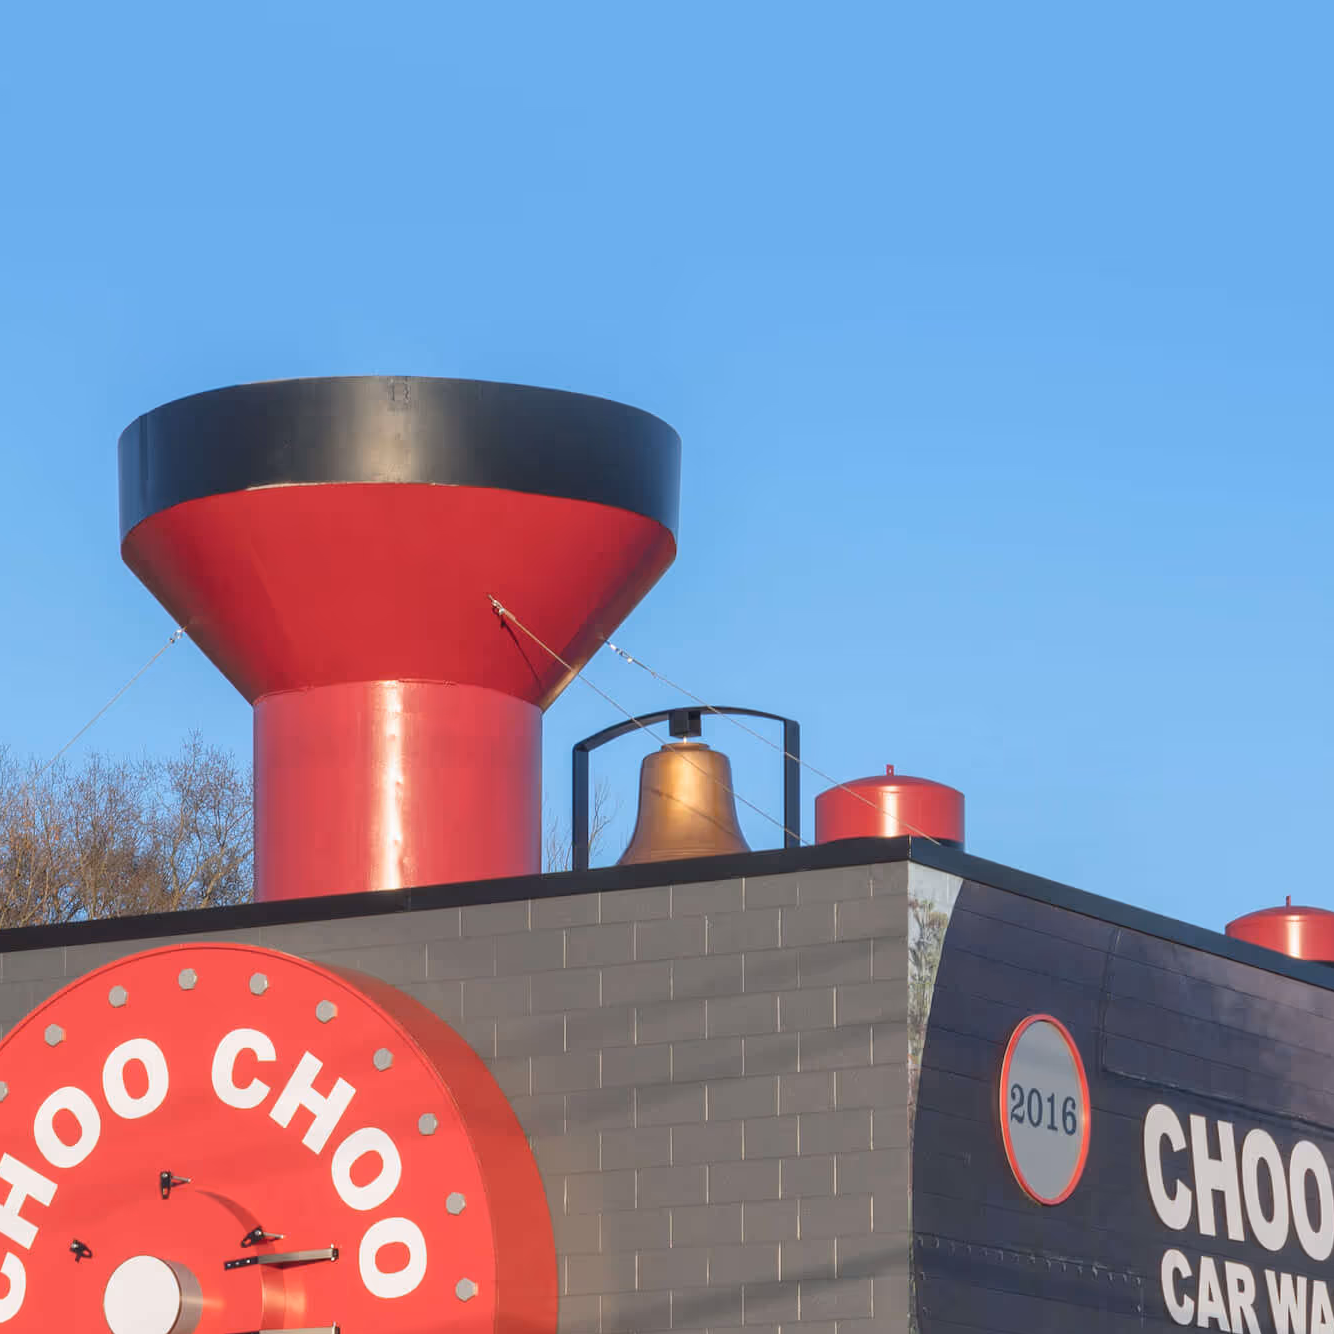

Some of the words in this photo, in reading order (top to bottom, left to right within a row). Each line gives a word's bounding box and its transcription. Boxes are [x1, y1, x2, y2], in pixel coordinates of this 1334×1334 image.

[210, 1027, 428, 1300] CHOO
[1010, 1082, 1077, 1136] 2016
[1143, 1103, 1334, 1261] CHOO
